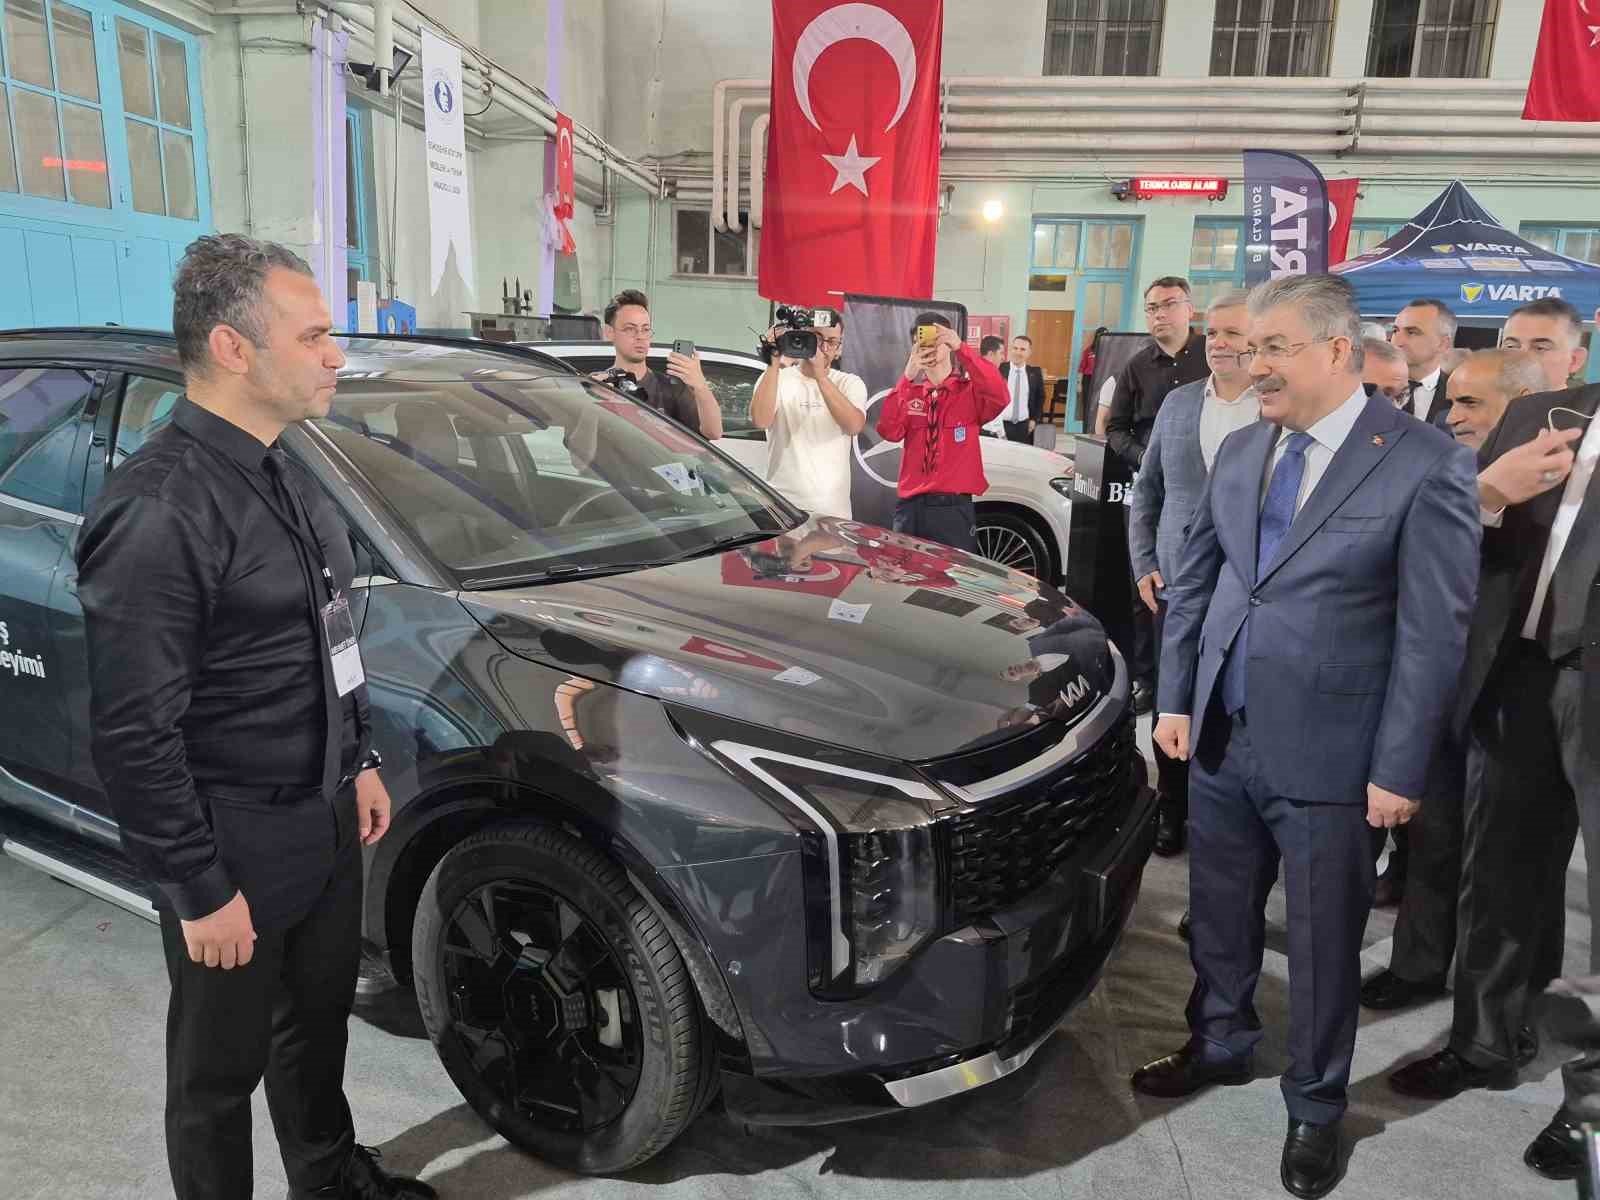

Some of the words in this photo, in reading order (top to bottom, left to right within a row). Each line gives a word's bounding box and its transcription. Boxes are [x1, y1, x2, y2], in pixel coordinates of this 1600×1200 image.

[1457, 242, 1531, 255] VARTA
[1487, 285, 1562, 302] VARTA
[1107, 482, 1132, 505] Bi
[0, 648, 46, 678] eyimi
